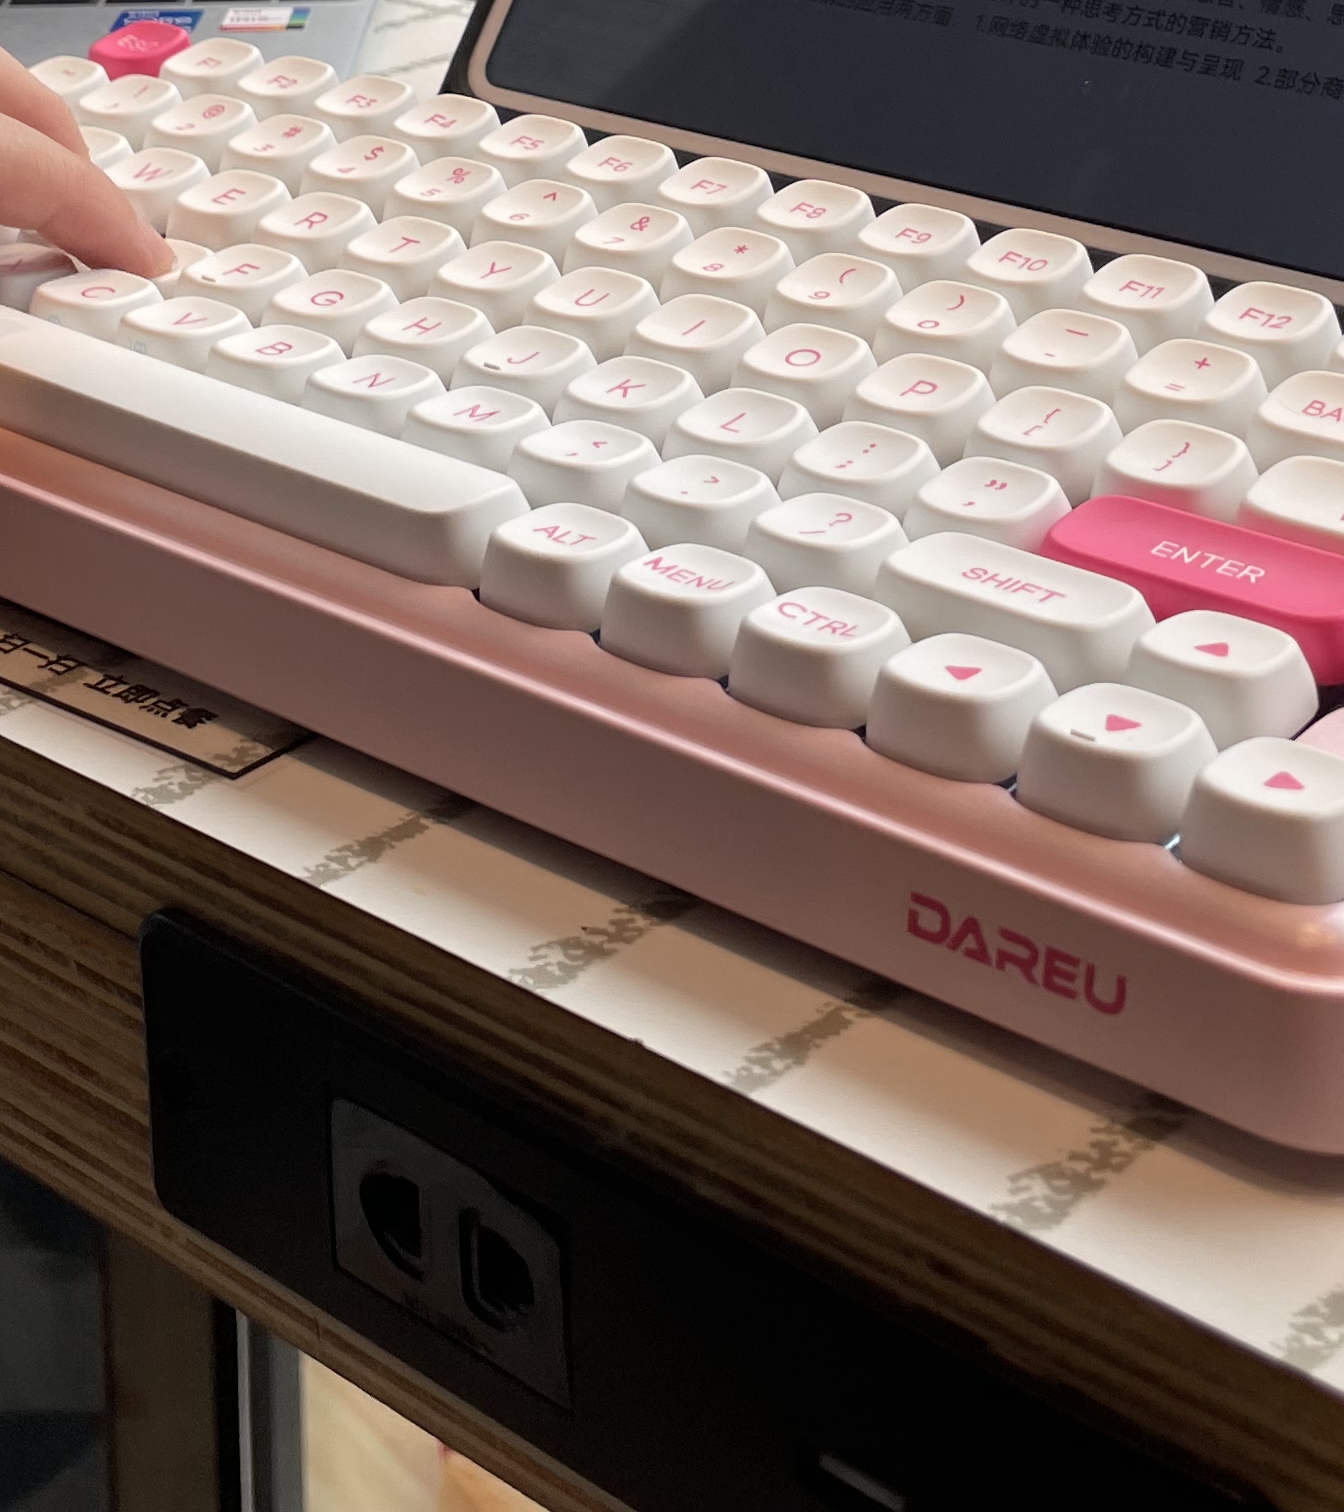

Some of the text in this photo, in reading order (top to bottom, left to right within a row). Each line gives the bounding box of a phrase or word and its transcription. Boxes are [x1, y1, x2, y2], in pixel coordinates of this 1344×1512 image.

[267, 75, 298, 88] F2
[346, 94, 377, 108] F3
[424, 114, 456, 128] F4
[510, 136, 545, 150] F5
[364, 146, 384, 161] $
[134, 162, 173, 181] W
[597, 156, 633, 172] F6
[446, 167, 472, 184] %
[690, 179, 730, 195] F7
[212, 188, 246, 205] E
[509, 213, 531, 221] 6
[789, 201, 827, 219] F8
[294, 211, 328, 229] R
[630, 216, 651, 231] &
[894, 227, 933, 244] F9
[388, 236, 421, 254] T
[222, 263, 260, 275] F
[480, 261, 512, 279] Y
[702, 262, 724, 272] 8
[998, 250, 1049, 272] F10
[81, 286, 116, 299] C
[310, 290, 345, 307] G
[574, 288, 610, 307] U
[808, 291, 831, 300] 9
[1118, 279, 1165, 300] F11
[172, 312, 209, 325] V
[402, 317, 442, 336] H
[1238, 306, 1293, 330] F12
[255, 341, 293, 355] B
[506, 351, 541, 365] J
[784, 348, 821, 367] O
[352, 372, 397, 388] N
[606, 379, 647, 398] K
[899, 379, 938, 397] P
[453, 404, 501, 424] M
[719, 412, 746, 433] L
[533, 524, 597, 546] ALT
[1149, 540, 1266, 584] ENTER
[643, 556, 736, 593] MENU
[960, 566, 1067, 604] SHIFT
[777, 601, 861, 638] CTRL
[82, 672, 219, 729] 立即点餐
[906, 890, 1127, 1016] DAREU
